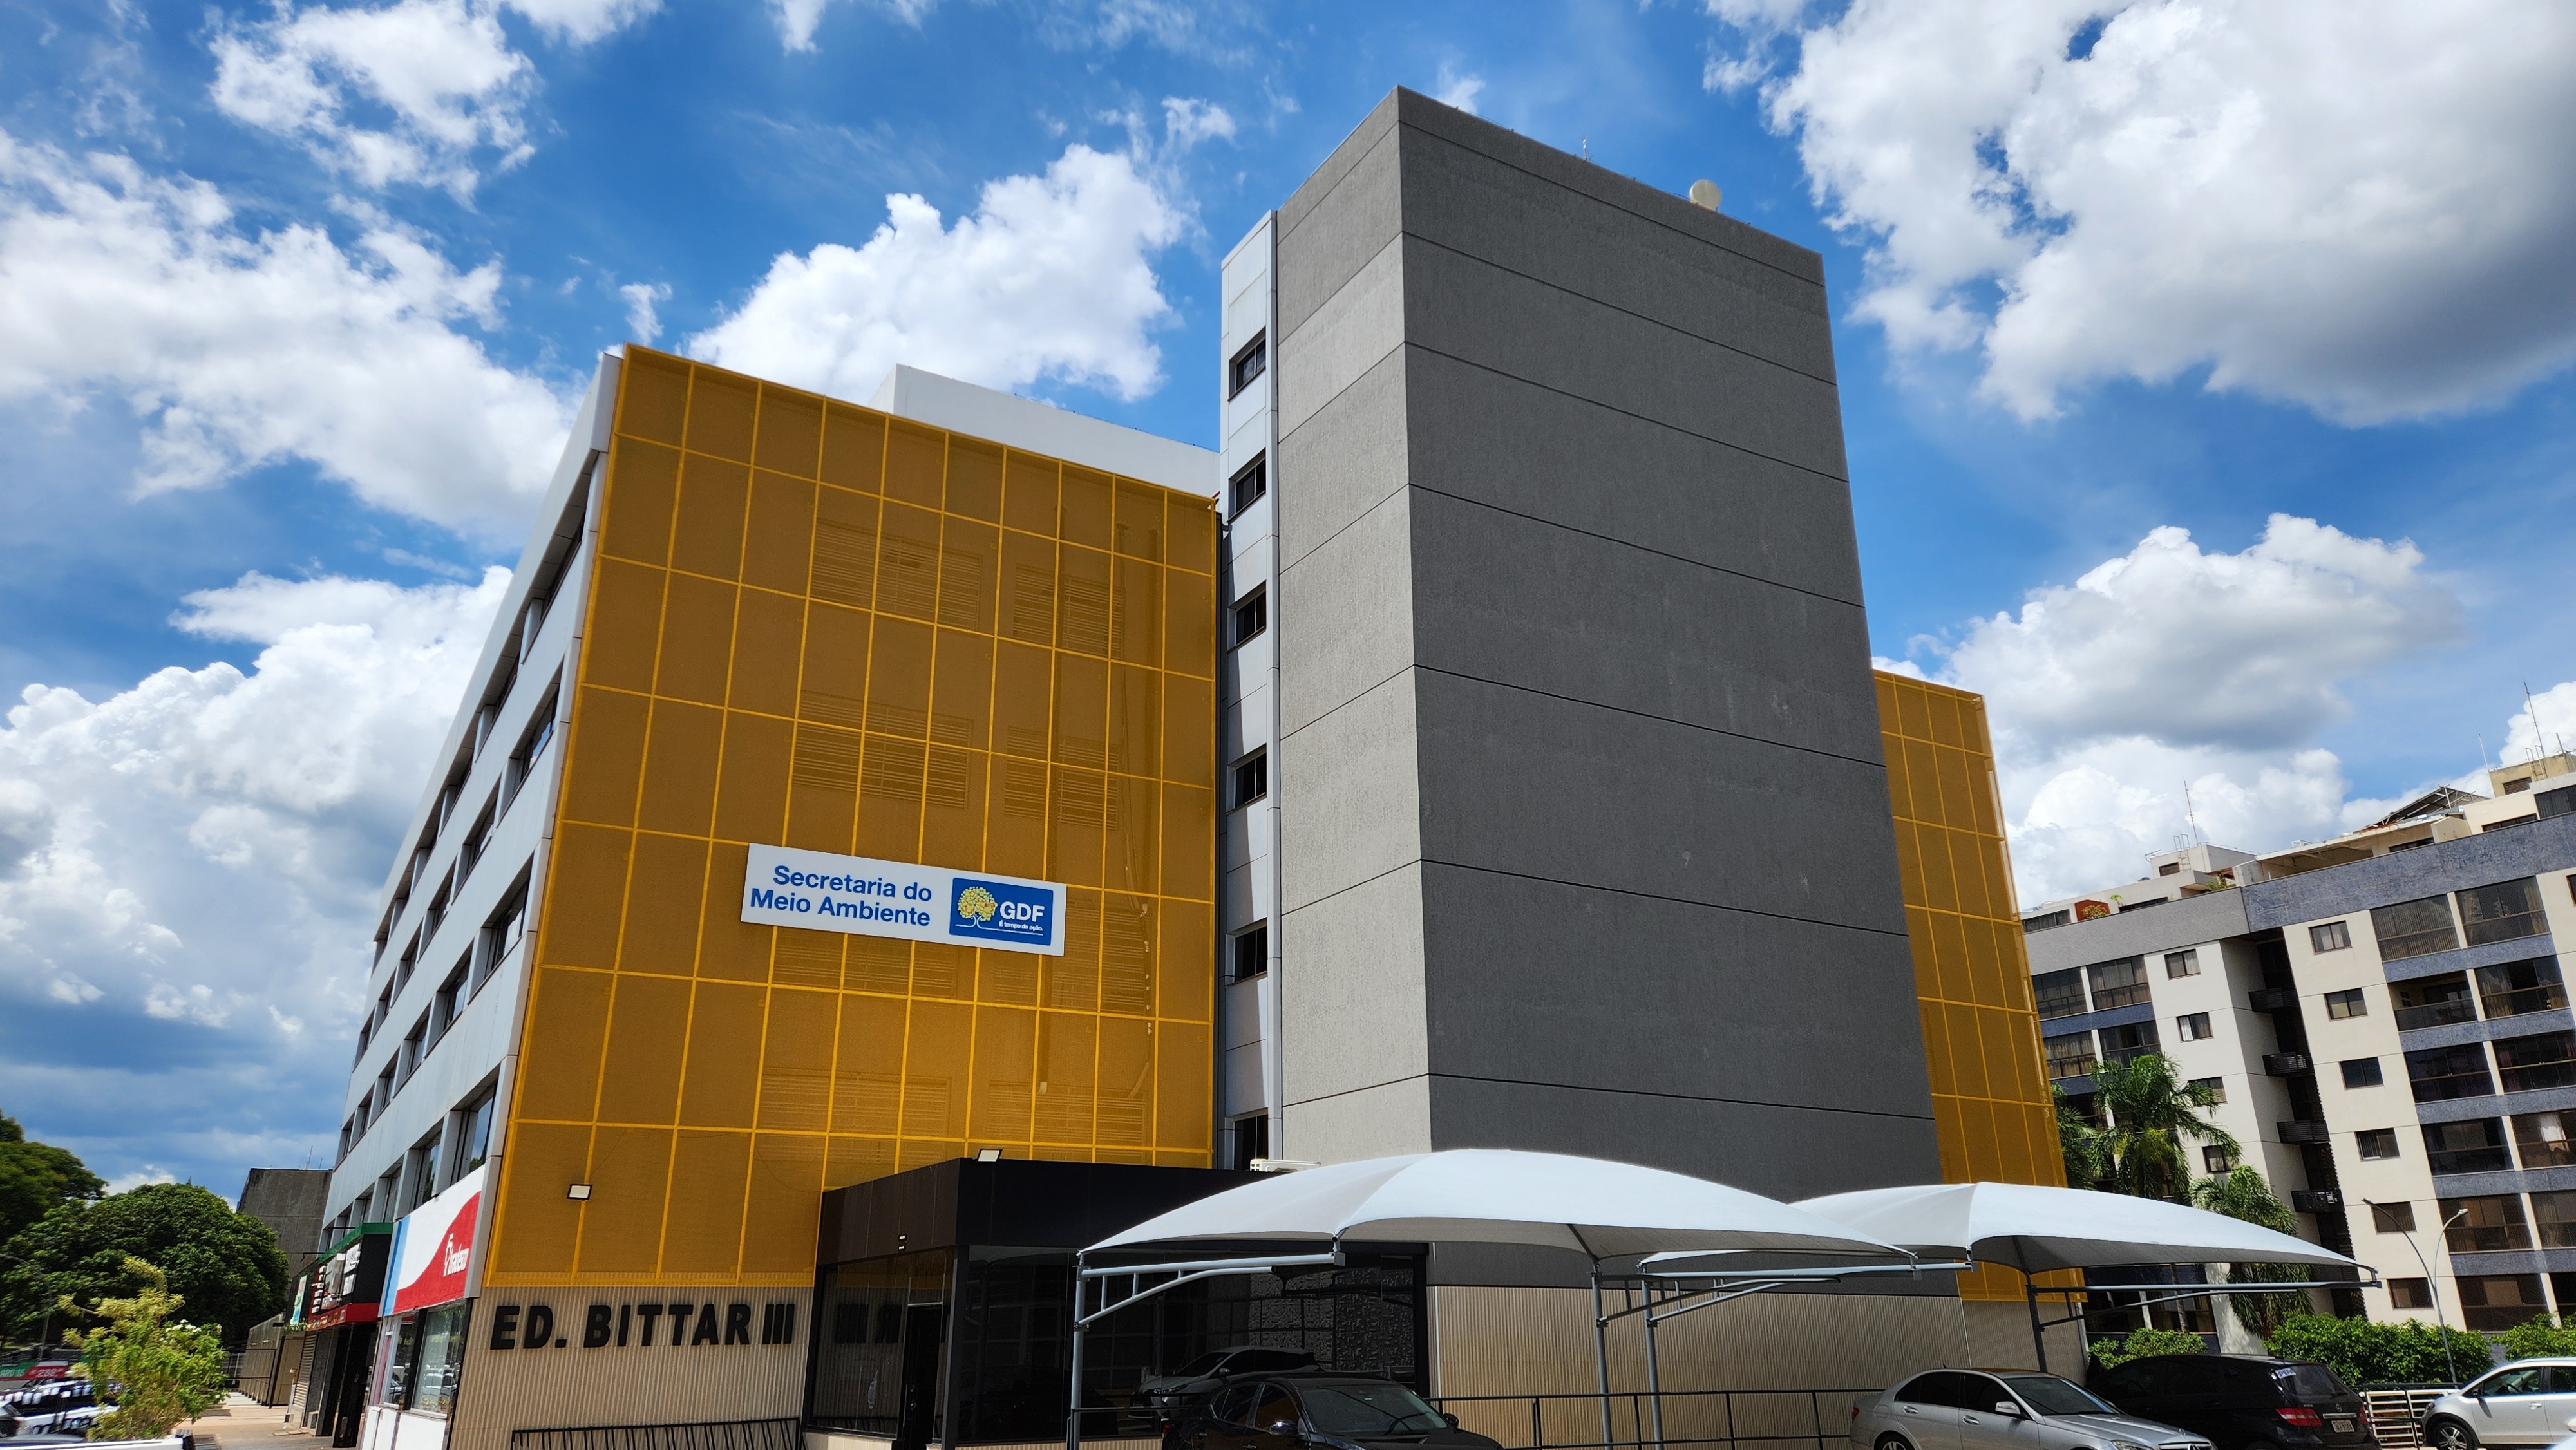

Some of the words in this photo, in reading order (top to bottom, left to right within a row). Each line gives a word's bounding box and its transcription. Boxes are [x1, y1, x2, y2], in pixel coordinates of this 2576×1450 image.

[773, 865, 896, 898] Secretaria
[904, 882, 932, 901] do
[750, 888, 811, 912] Meio
[818, 896, 931, 926] Ambiente
[1000, 901, 1045, 922] GDF
[489, 1305, 567, 1350] ED.
[583, 1303, 752, 1348] BITTAR
[761, 1304, 795, 1344] III
